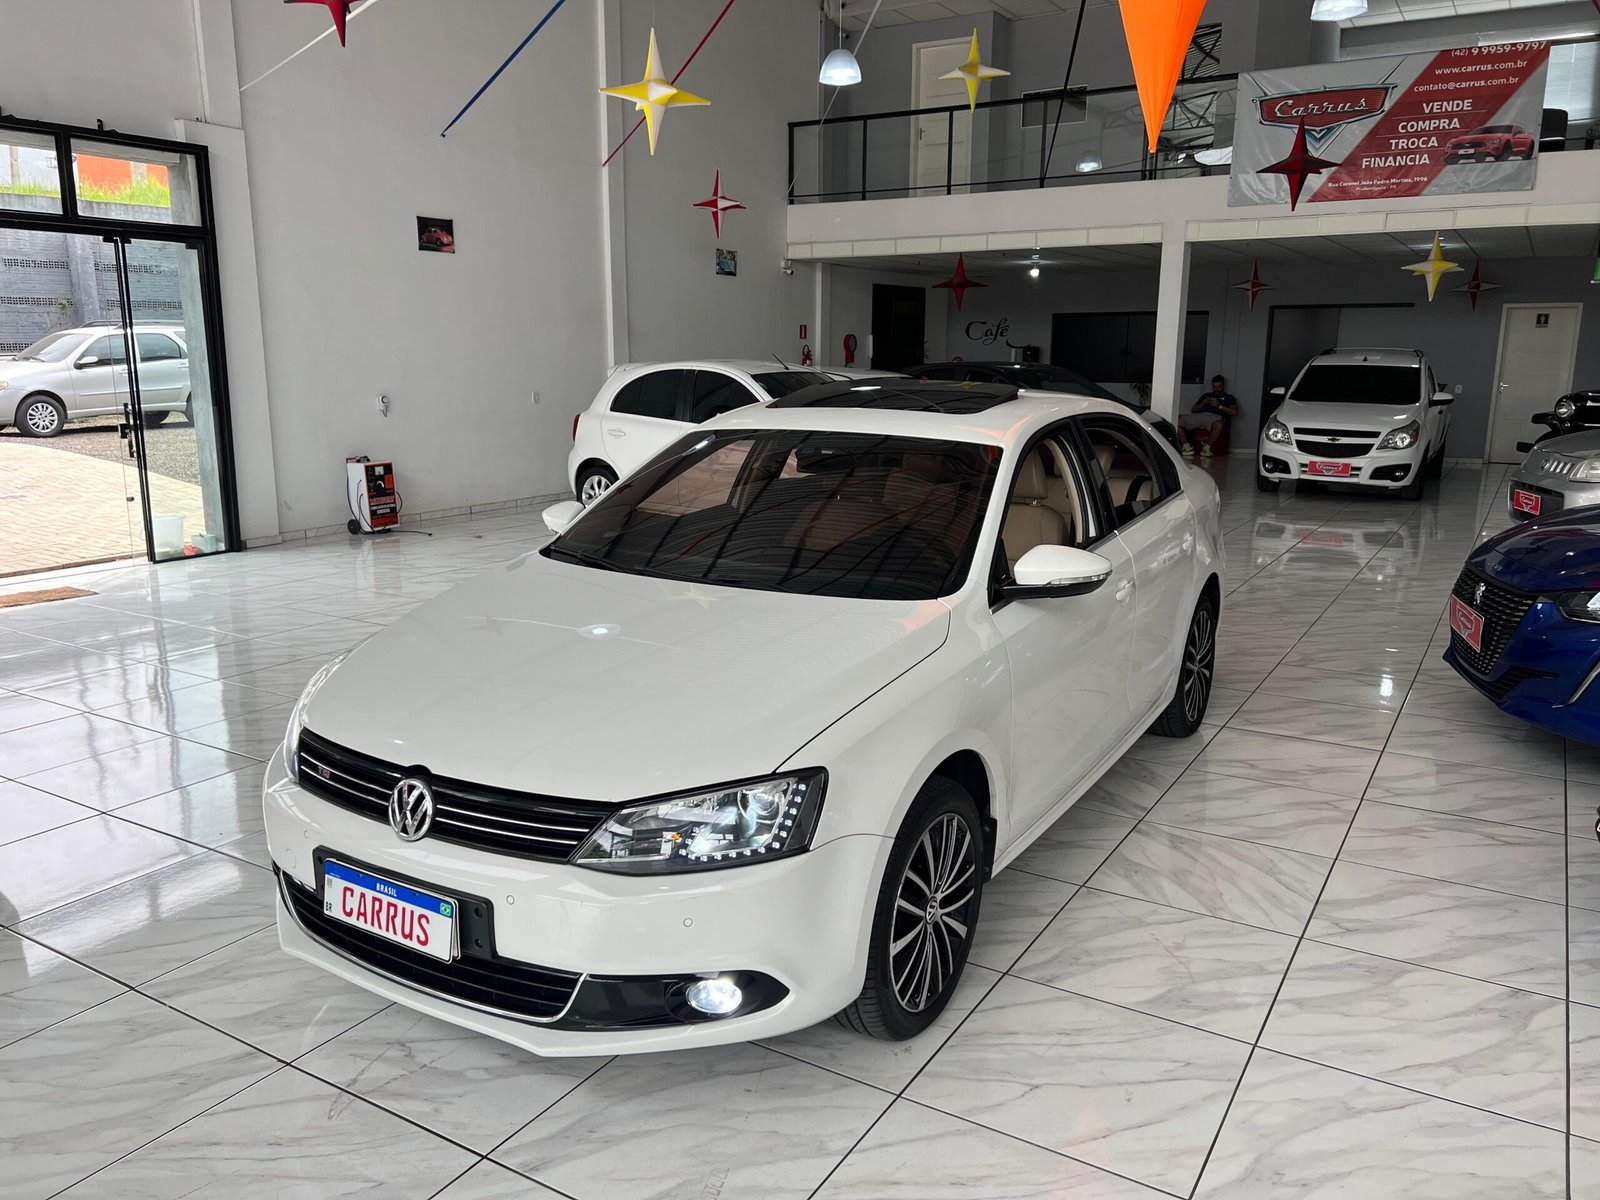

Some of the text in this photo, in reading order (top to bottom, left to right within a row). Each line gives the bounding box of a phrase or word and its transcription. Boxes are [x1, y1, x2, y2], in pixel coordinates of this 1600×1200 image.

[1451, 40, 1546, 57] (42) 9 9959-9797
[1435, 60, 1528, 75] www.carrus.com.br
[1413, 75, 1520, 93] contato@carrus.com.br
[1275, 97, 1369, 117] Carrus
[1423, 99, 1473, 114] VENDE
[1398, 118, 1460, 133] COMPRA
[1389, 136, 1438, 150] TROCA
[1361, 153, 1430, 168] FINANCIA
[376, 883, 397, 898] BRASIL
[341, 886, 430, 947] CARRUS
